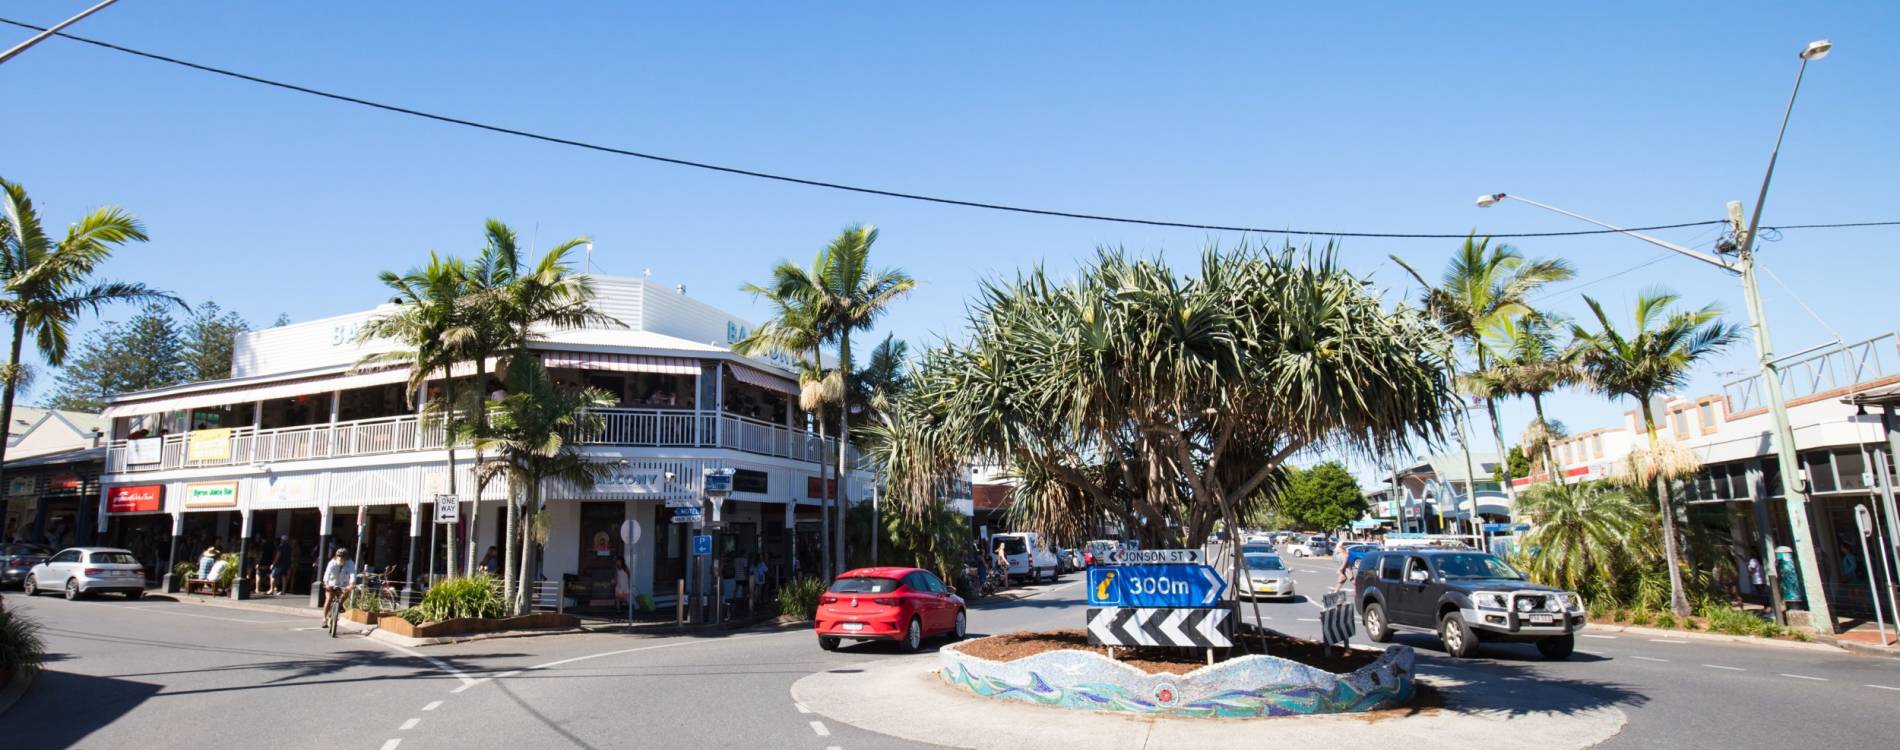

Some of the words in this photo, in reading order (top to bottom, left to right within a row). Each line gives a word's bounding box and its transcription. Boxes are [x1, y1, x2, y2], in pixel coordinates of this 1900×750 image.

[595, 474, 657, 485] ALCONY
[1123, 552, 1167, 561] JONSON
[1171, 552, 1183, 560] ST
[1130, 577, 1189, 595] 300m
